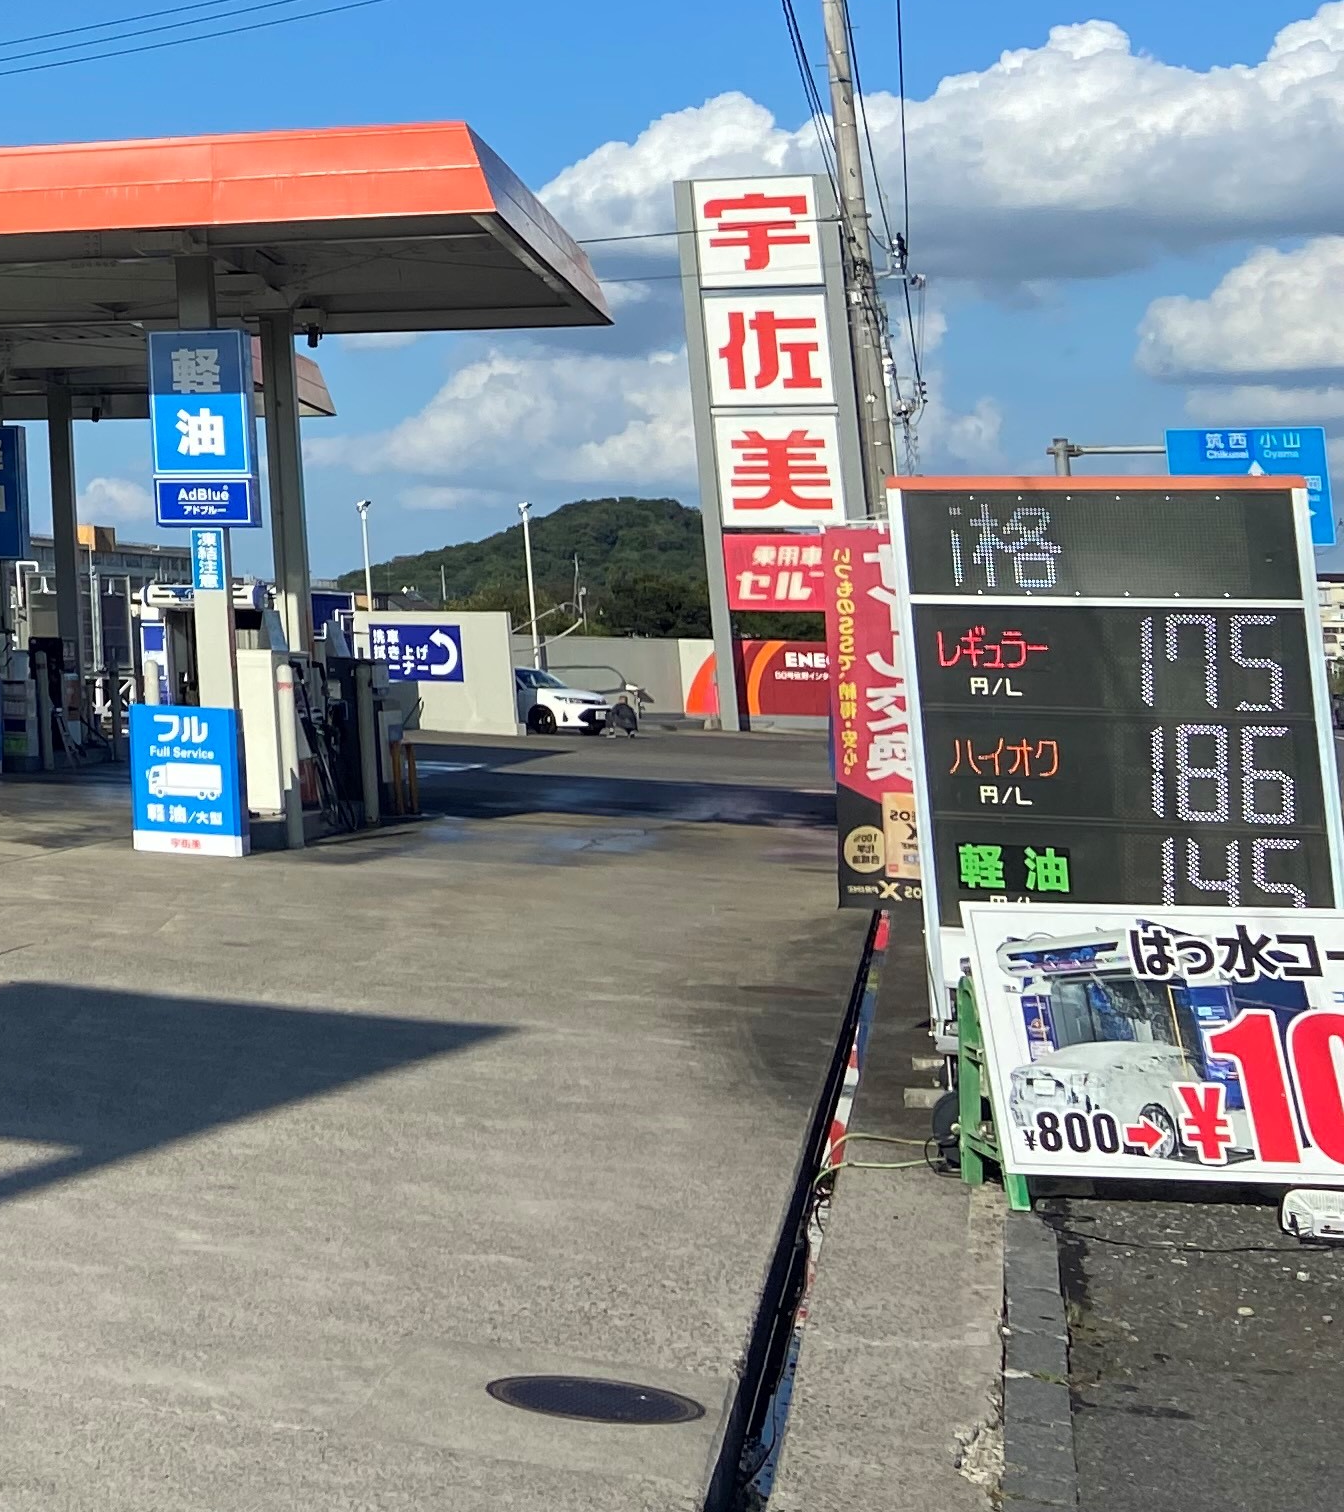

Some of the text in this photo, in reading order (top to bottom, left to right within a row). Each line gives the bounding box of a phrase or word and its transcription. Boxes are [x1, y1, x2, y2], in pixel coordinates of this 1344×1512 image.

[703, 193, 834, 511] 宇佐美
[171, 348, 226, 456] 軽油
[1205, 432, 1300, 449] 筑西 小山
[183, 506, 226, 515] アドブルー
[197, 532, 219, 588] 凍結注意
[752, 546, 823, 566] 乗用車
[373, 629, 399, 643] 洗車
[389, 662, 429, 675] ーナー
[785, 652, 829, 668] ENE
[937, 614, 1284, 711] レギュラー 175
[970, 678, 1022, 697] 円/L
[153, 714, 208, 743] フル
[149, 745, 214, 759] Full Service
[950, 724, 1295, 824] ハイオク 186
[979, 786, 1032, 805] 円/L
[959, 838, 1305, 908] 軽油 145
[1023, 1112, 1119, 1153] ¥800
